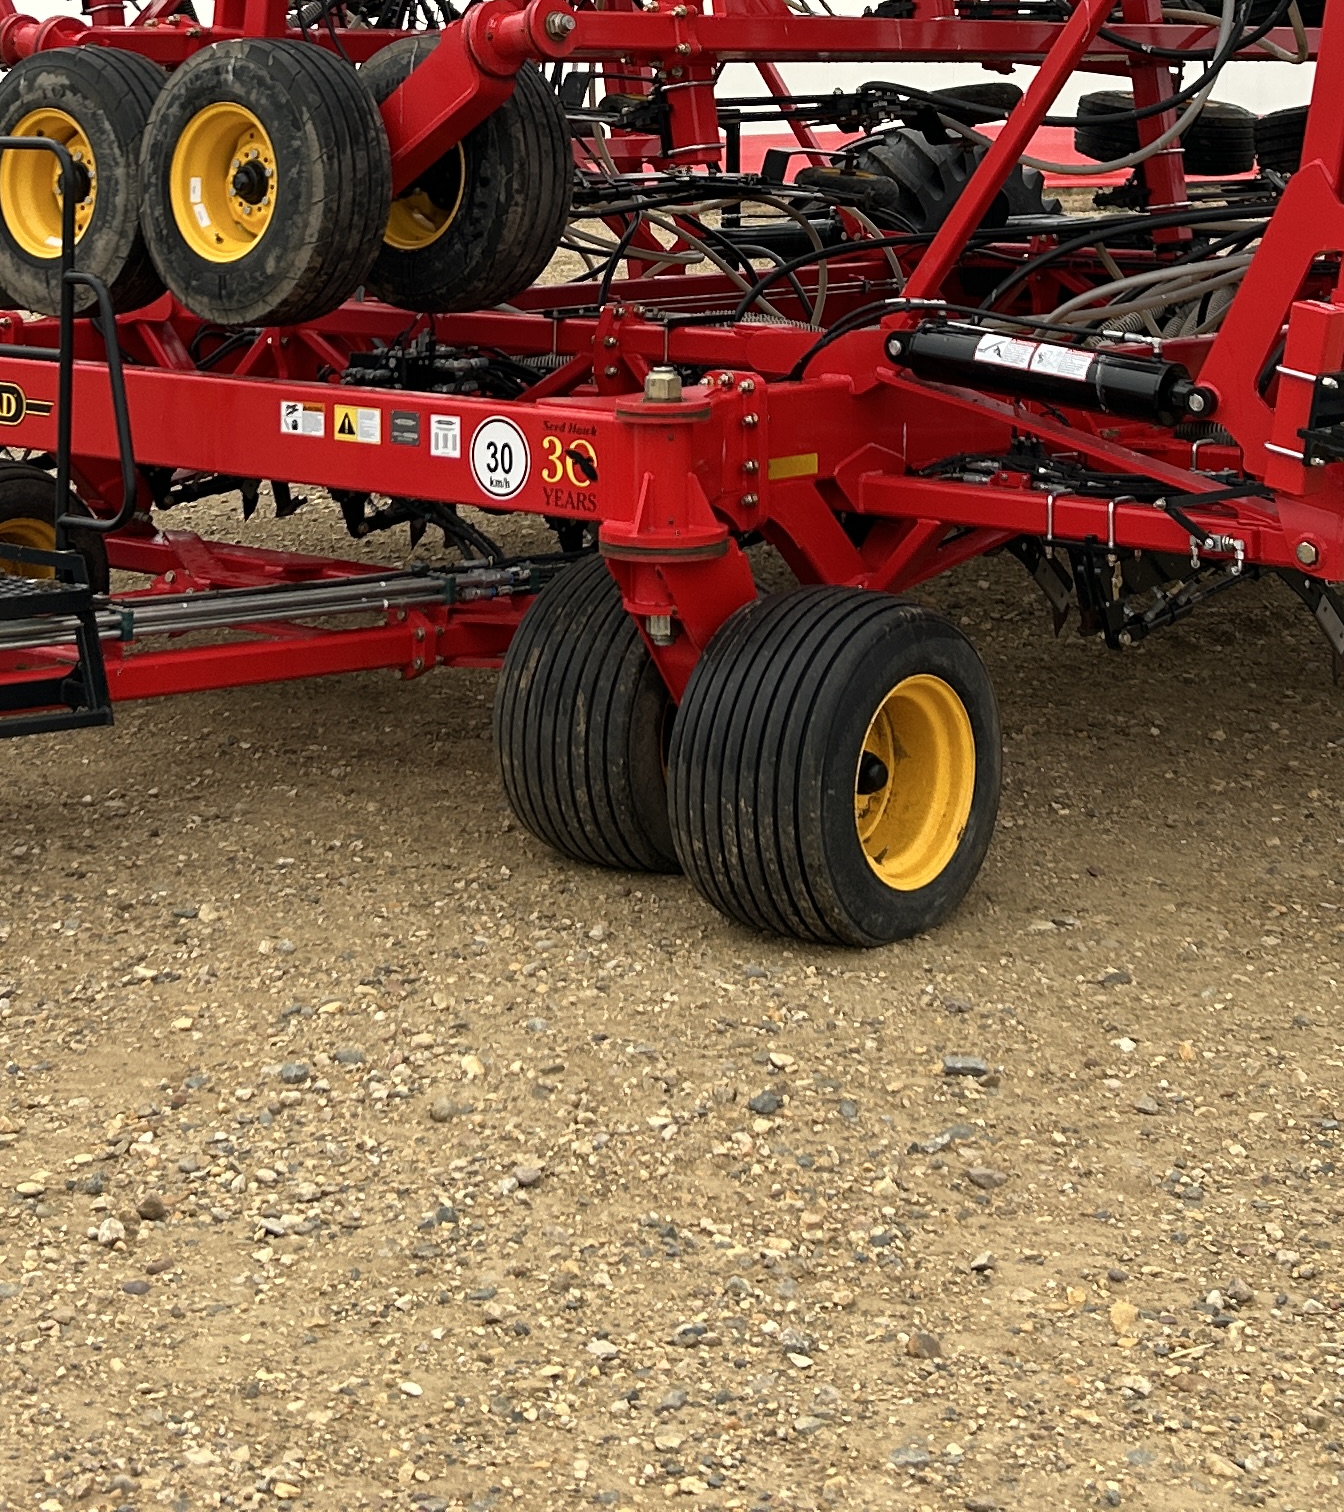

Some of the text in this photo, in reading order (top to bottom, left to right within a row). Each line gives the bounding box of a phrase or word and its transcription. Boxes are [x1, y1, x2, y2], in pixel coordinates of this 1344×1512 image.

[542, 420, 597, 436] Seed Hawk
[486, 440, 513, 475] 30
[541, 435, 598, 488] 30
[489, 476, 511, 489] km/h
[542, 487, 597, 513] YEARS
